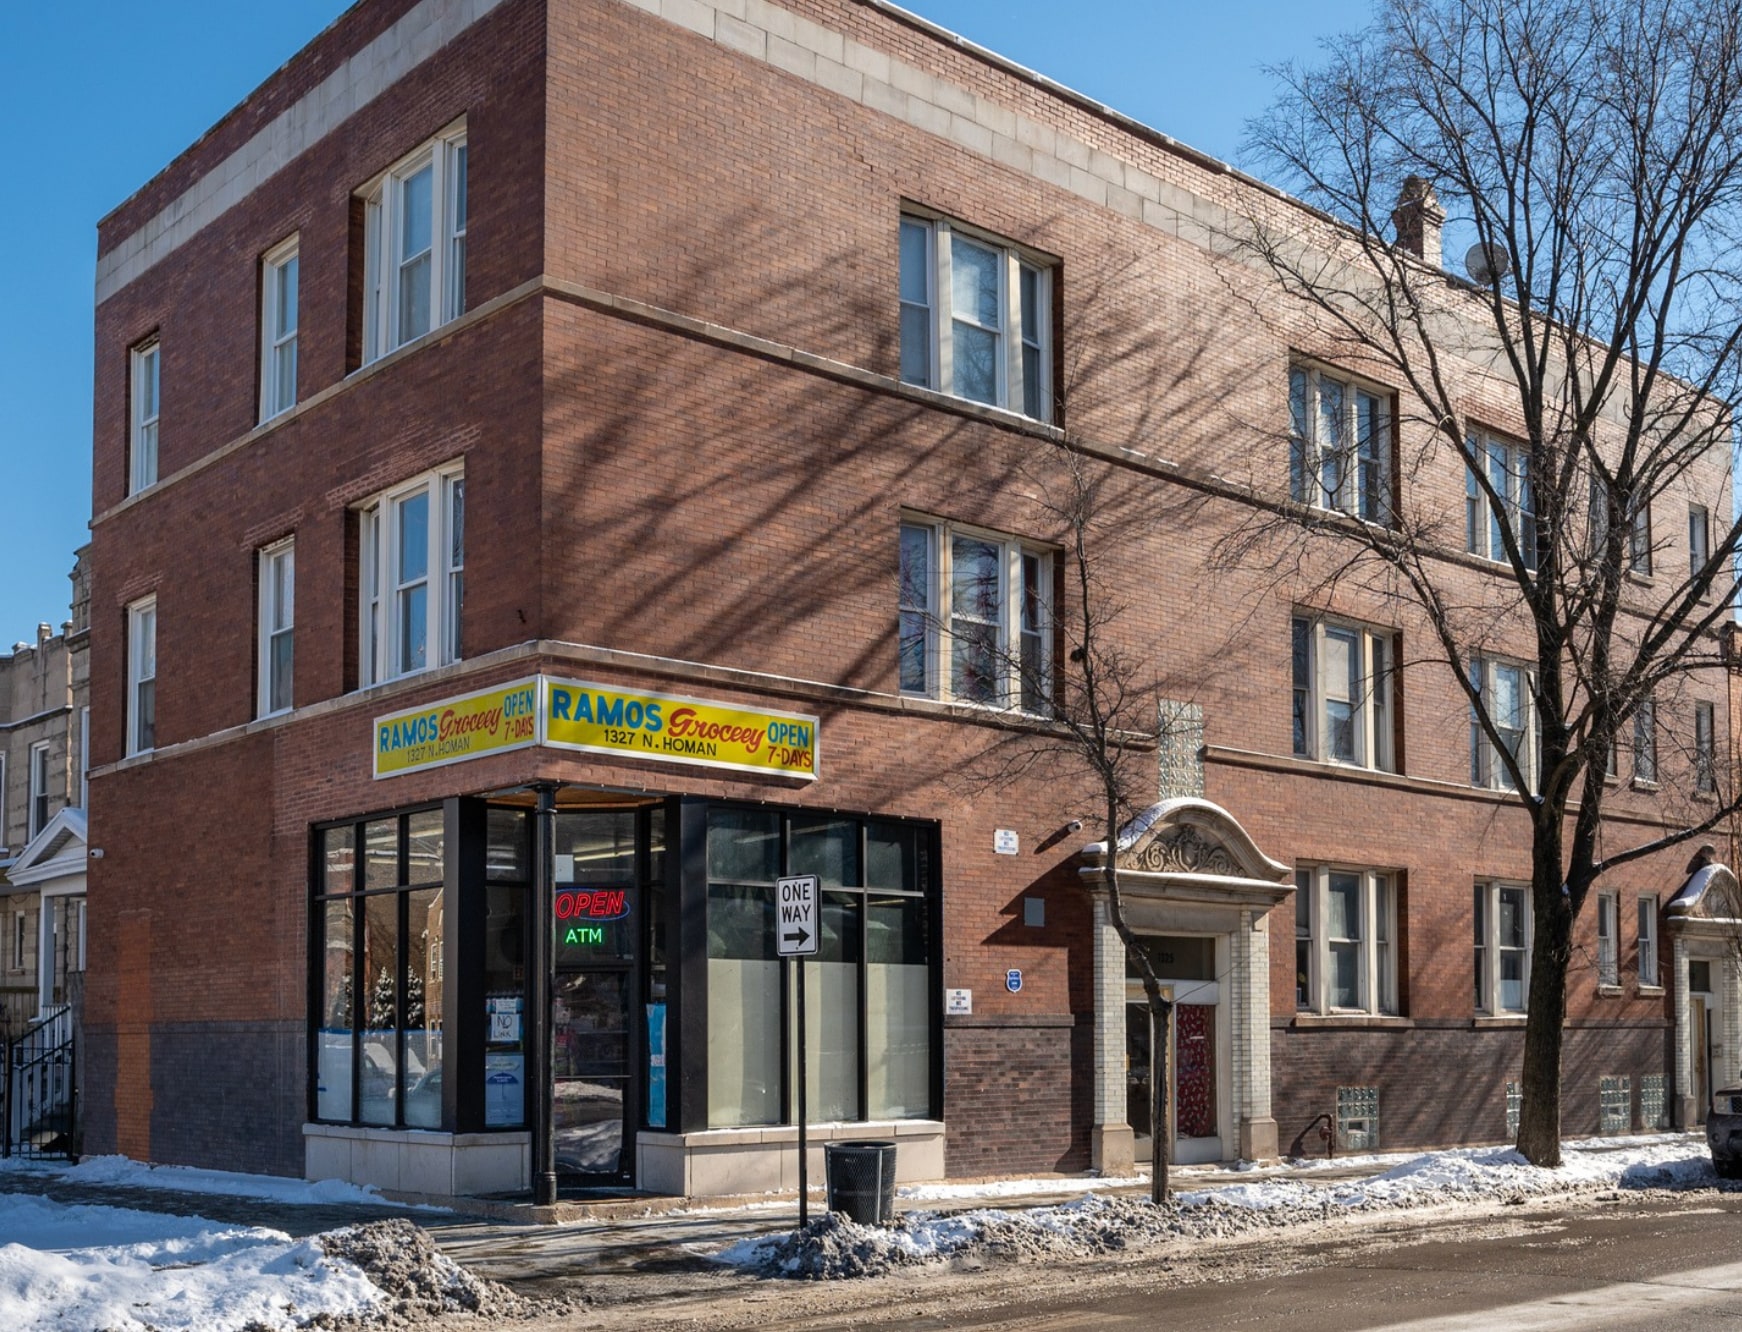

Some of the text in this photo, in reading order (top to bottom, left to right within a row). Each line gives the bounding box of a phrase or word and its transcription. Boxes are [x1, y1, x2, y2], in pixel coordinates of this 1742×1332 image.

[504, 689, 534, 718] OPEN
[552, 689, 663, 732] RAMOS
[380, 714, 438, 752] RAMOS
[504, 716, 534, 741] 7-DAYS
[767, 721, 809, 748] OPEN
[407, 747, 426, 763] 1327
[439, 736, 470, 756] HOMAN
[604, 729, 635, 745] 1327
[663, 738, 717, 757] HOMAN
[767, 746, 812, 768] 7-DAYS
[555, 891, 624, 919] OPEN
[782, 883, 811, 902] ONE
[781, 904, 811, 923] WAY
[565, 928, 602, 943] ATM
[497, 1015, 512, 1028] NO
